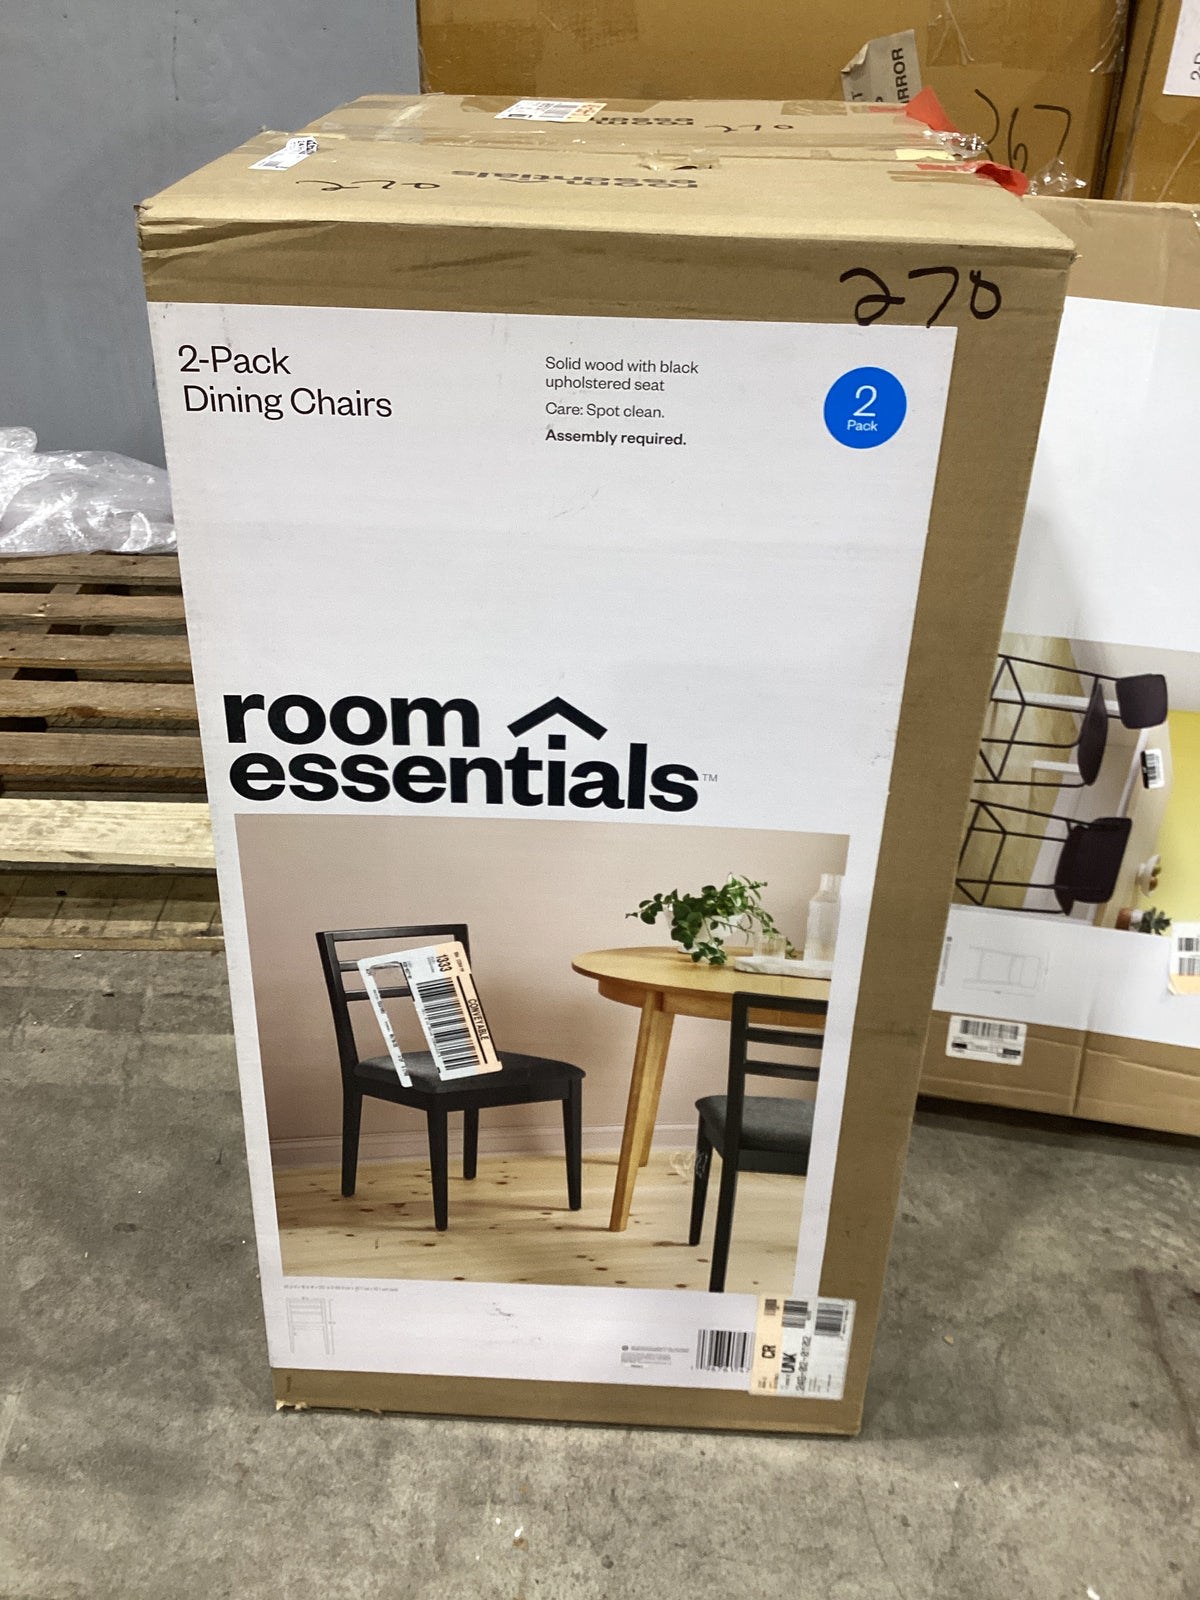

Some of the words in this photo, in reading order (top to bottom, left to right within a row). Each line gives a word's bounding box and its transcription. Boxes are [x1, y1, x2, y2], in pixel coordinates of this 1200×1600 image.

[839, 266, 1002, 329] 270
[178, 344, 291, 375] 2-Pack
[545, 356, 581, 370] Solid
[584, 359, 624, 372] wood
[627, 359, 656, 373] with
[660, 360, 699, 374] black
[545, 375, 631, 391] upholstered
[634, 379, 665, 391] seat
[183, 384, 284, 421] Dining
[290, 387, 393, 418] Chairs
[545, 401, 584, 416] Care:
[586, 403, 620, 419] Spot
[623, 405, 665, 418] clean.
[853, 384, 877, 417] 2
[545, 428, 618, 445] Assembly
[621, 432, 687, 446] required.
[847, 419, 878, 432] Pack
[223, 693, 481, 748] room
[229, 734, 699, 812] essentials
[436, 953, 453, 973] 1333
[467, 998, 489, 1041] CONVEYABLE
